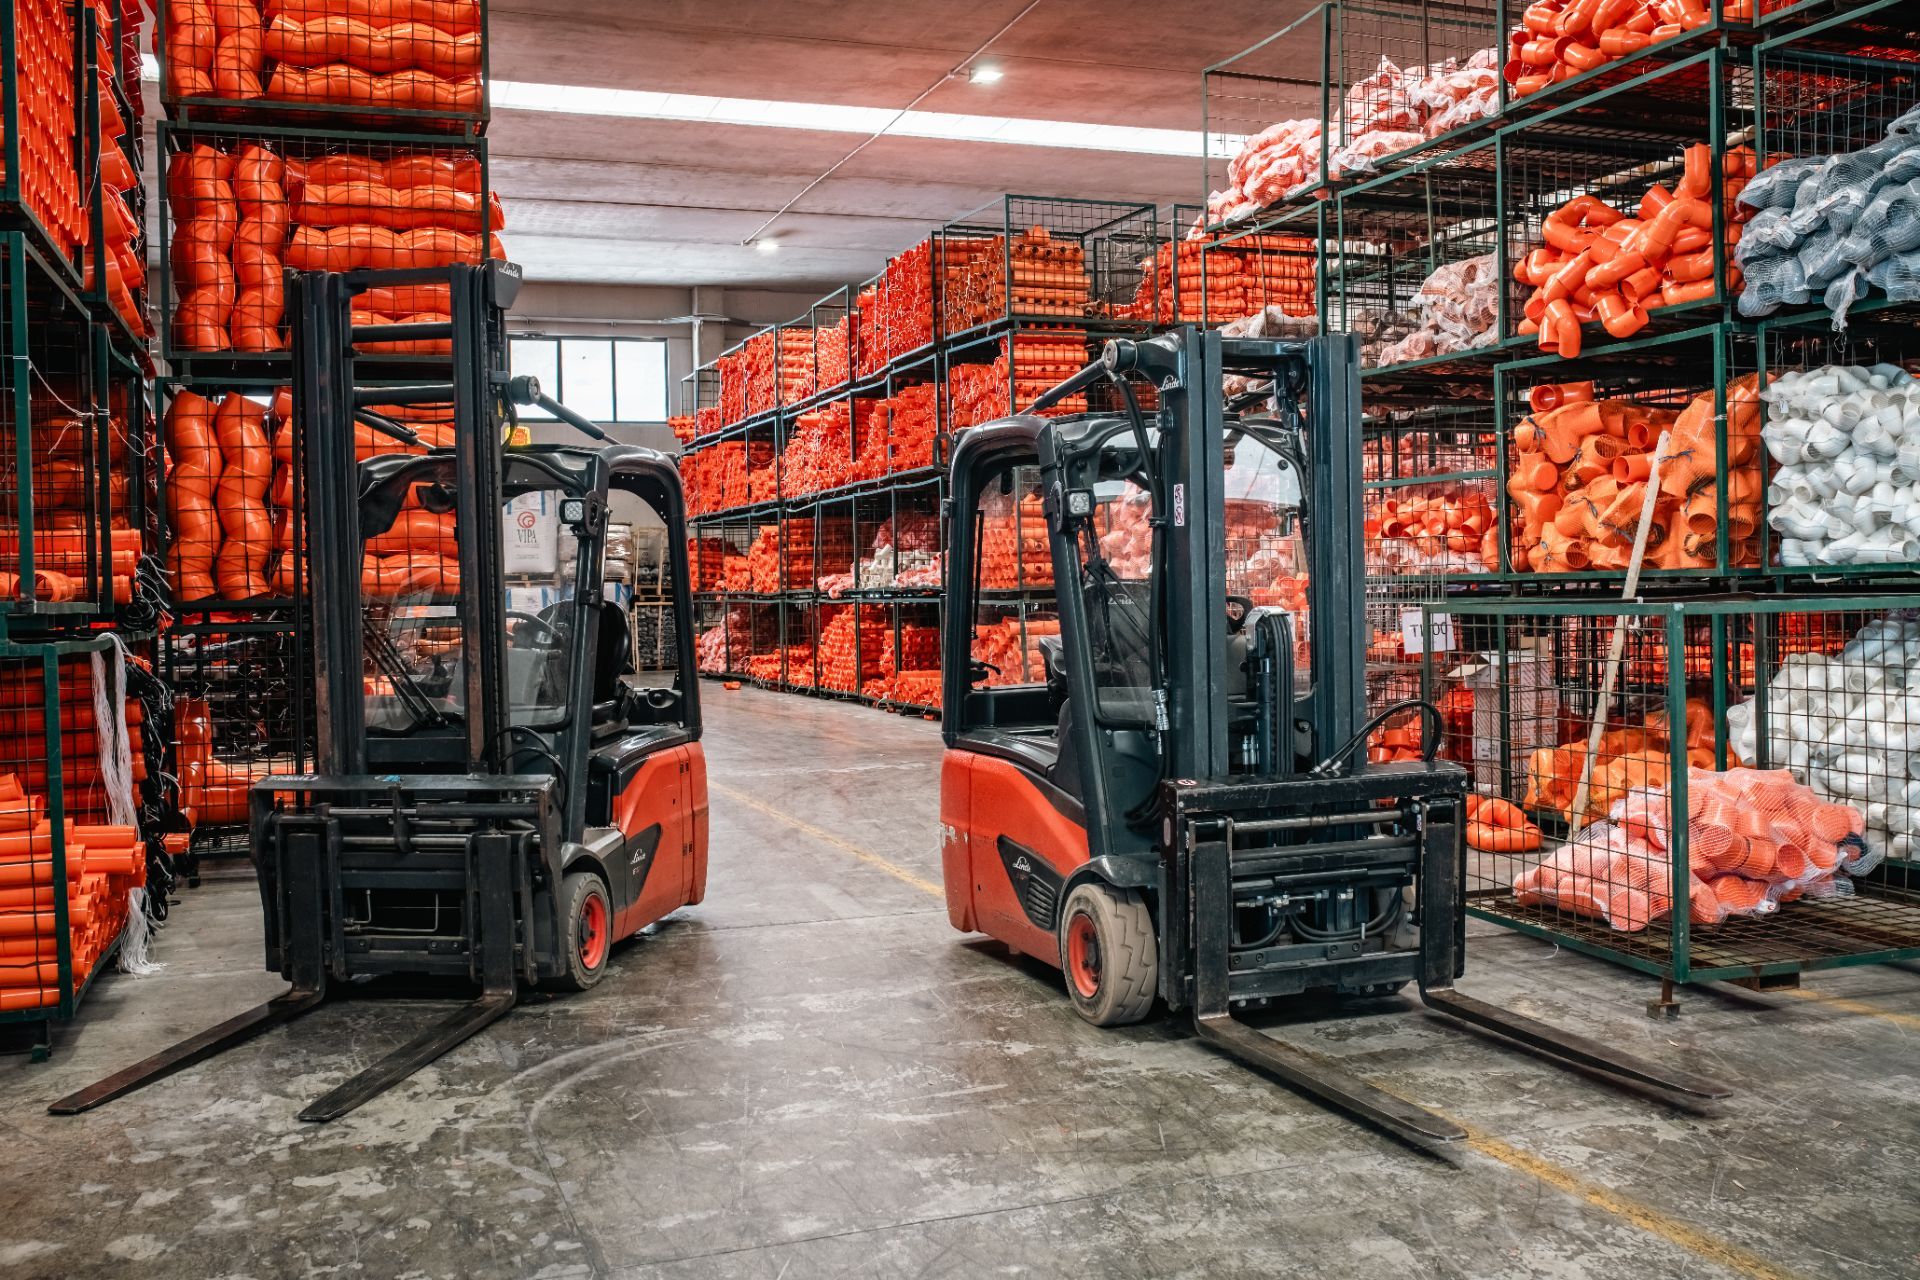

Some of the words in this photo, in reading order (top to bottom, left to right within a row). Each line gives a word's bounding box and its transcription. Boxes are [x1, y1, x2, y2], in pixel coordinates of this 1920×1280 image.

[499, 261, 520, 279] Linde
[1157, 374, 1180, 393] Linde
[517, 529, 537, 544] VIPA
[1012, 856, 1031, 873] Linde
